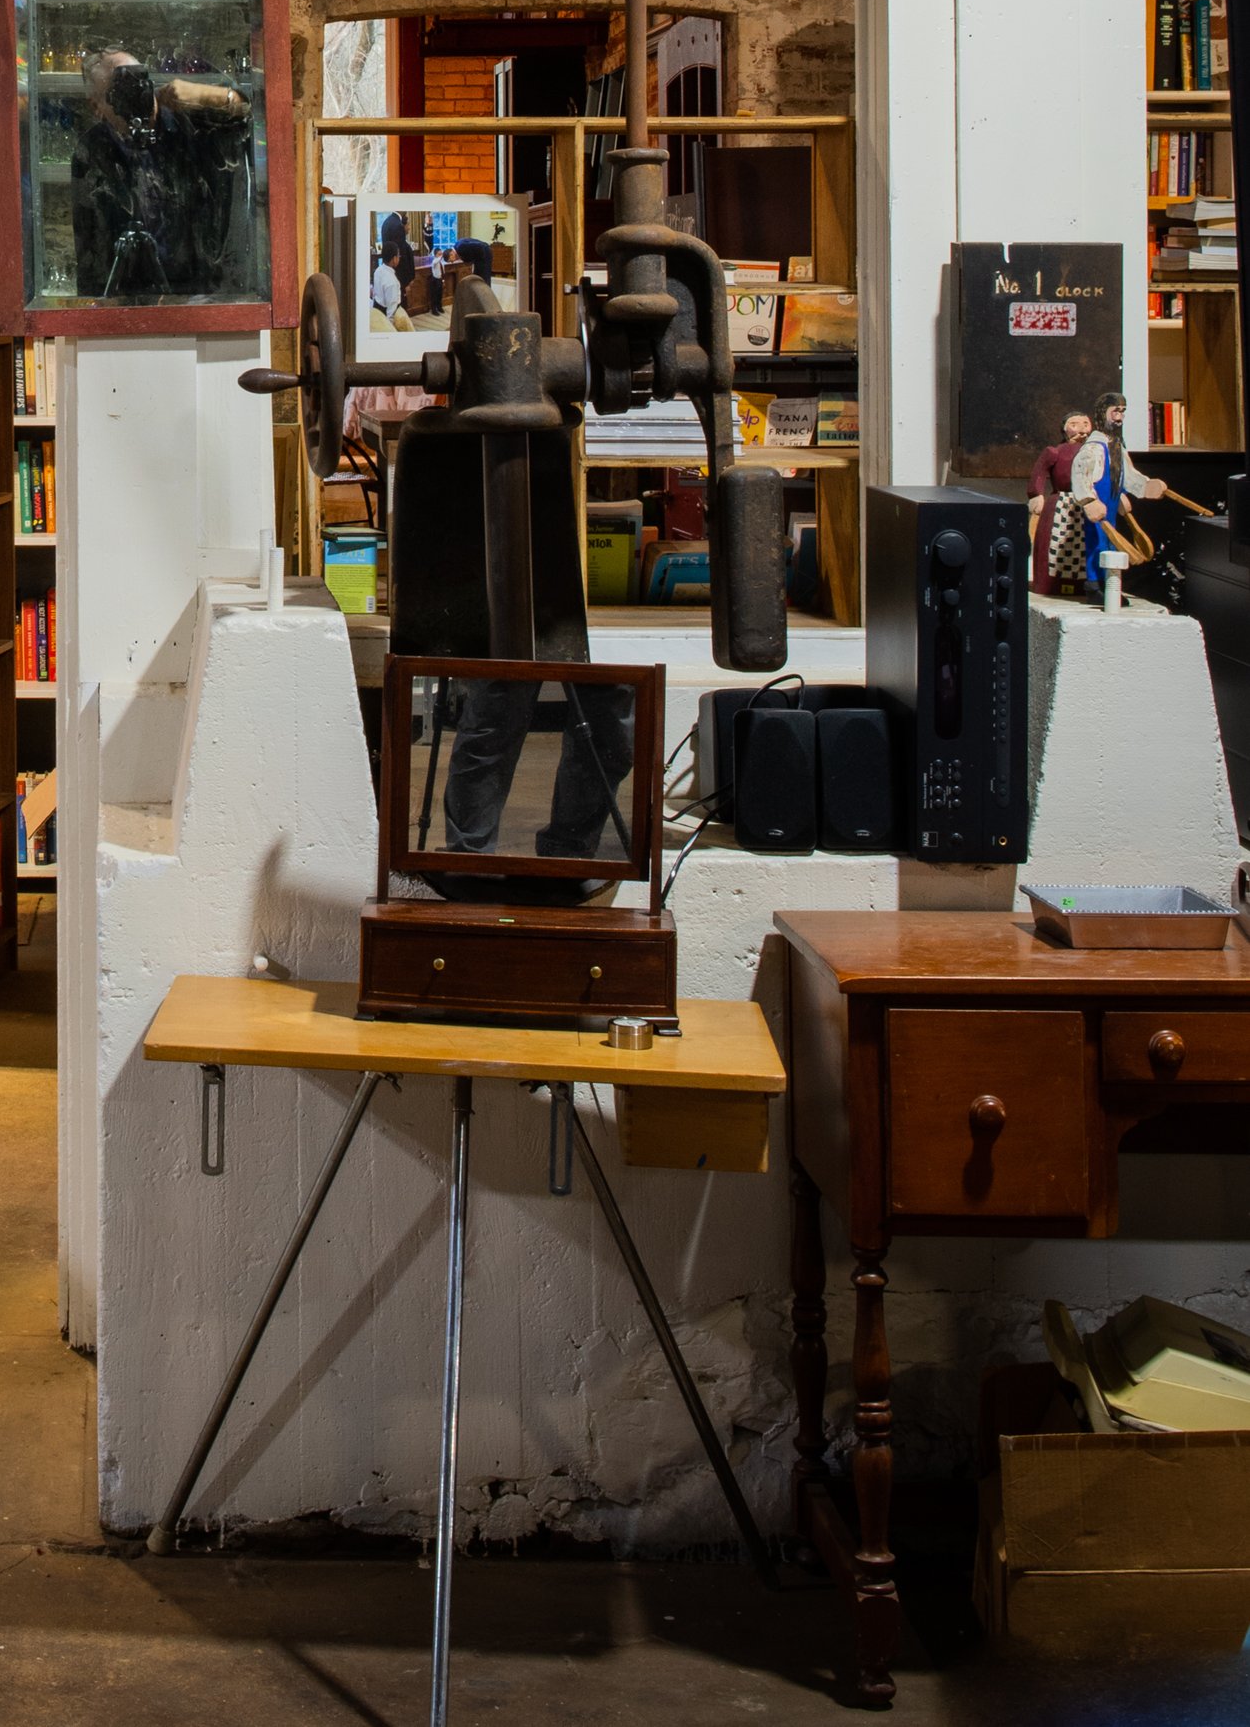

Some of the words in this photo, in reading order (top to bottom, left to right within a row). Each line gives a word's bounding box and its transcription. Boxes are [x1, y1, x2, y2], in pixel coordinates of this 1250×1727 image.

[994, 270, 1021, 295] No.
[1035, 270, 1043, 296] 1
[16, 359, 24, 378] DEAD
[16, 379, 24, 408] ENDERS
[778, 414, 809, 422] TANA
[768, 427, 813, 435] FRENCH
